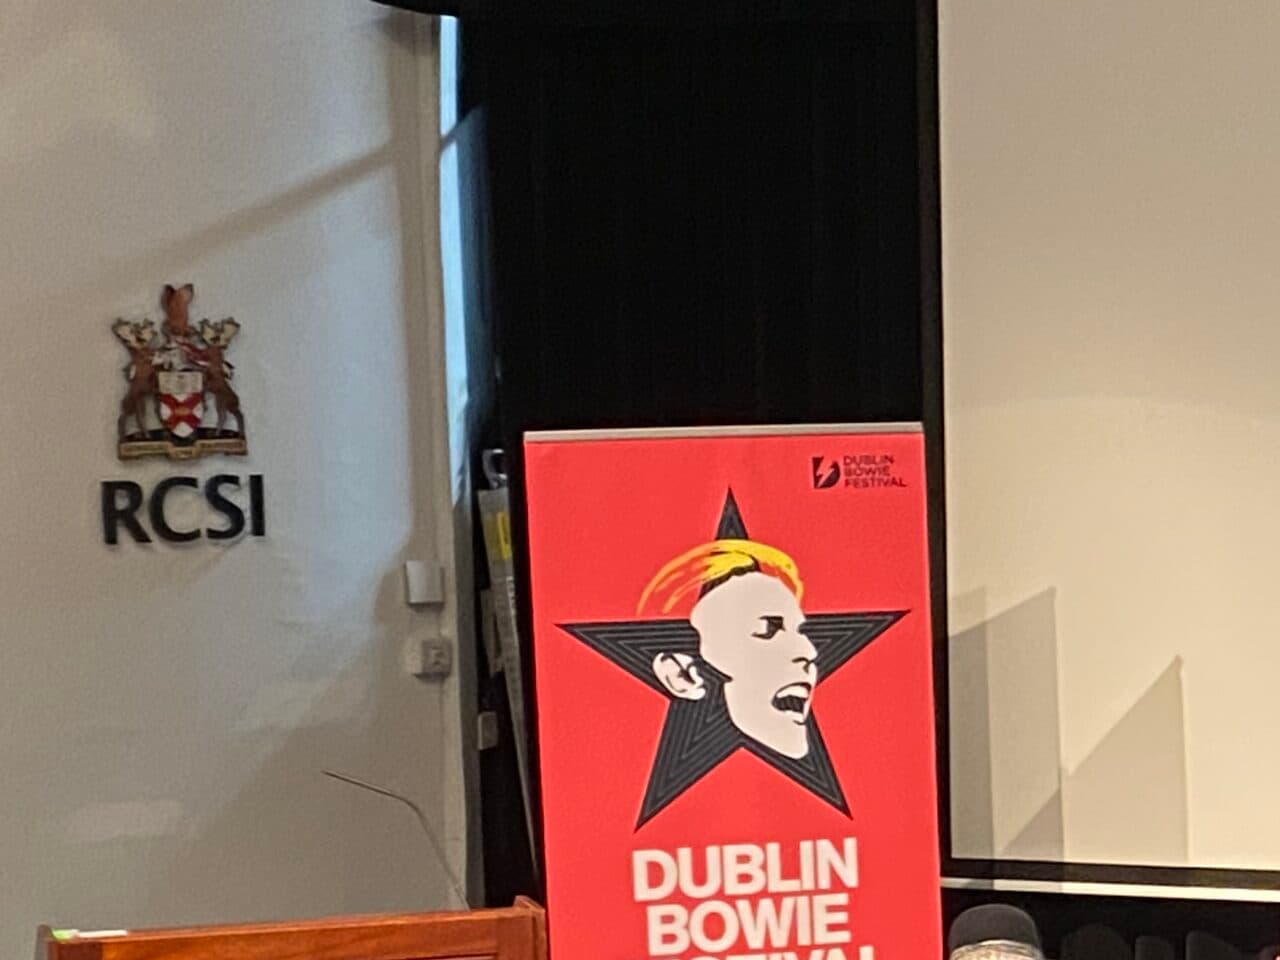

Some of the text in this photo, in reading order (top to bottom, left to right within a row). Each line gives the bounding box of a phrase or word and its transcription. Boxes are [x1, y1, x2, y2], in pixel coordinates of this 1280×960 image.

[843, 455, 895, 466] DUBLIN
[844, 466, 891, 477] BOWIE
[844, 477, 907, 489] FESTIVAL
[100, 474, 266, 545] RCSI
[632, 837, 859, 901] DUBLIN
[647, 893, 851, 956] BOWIE
